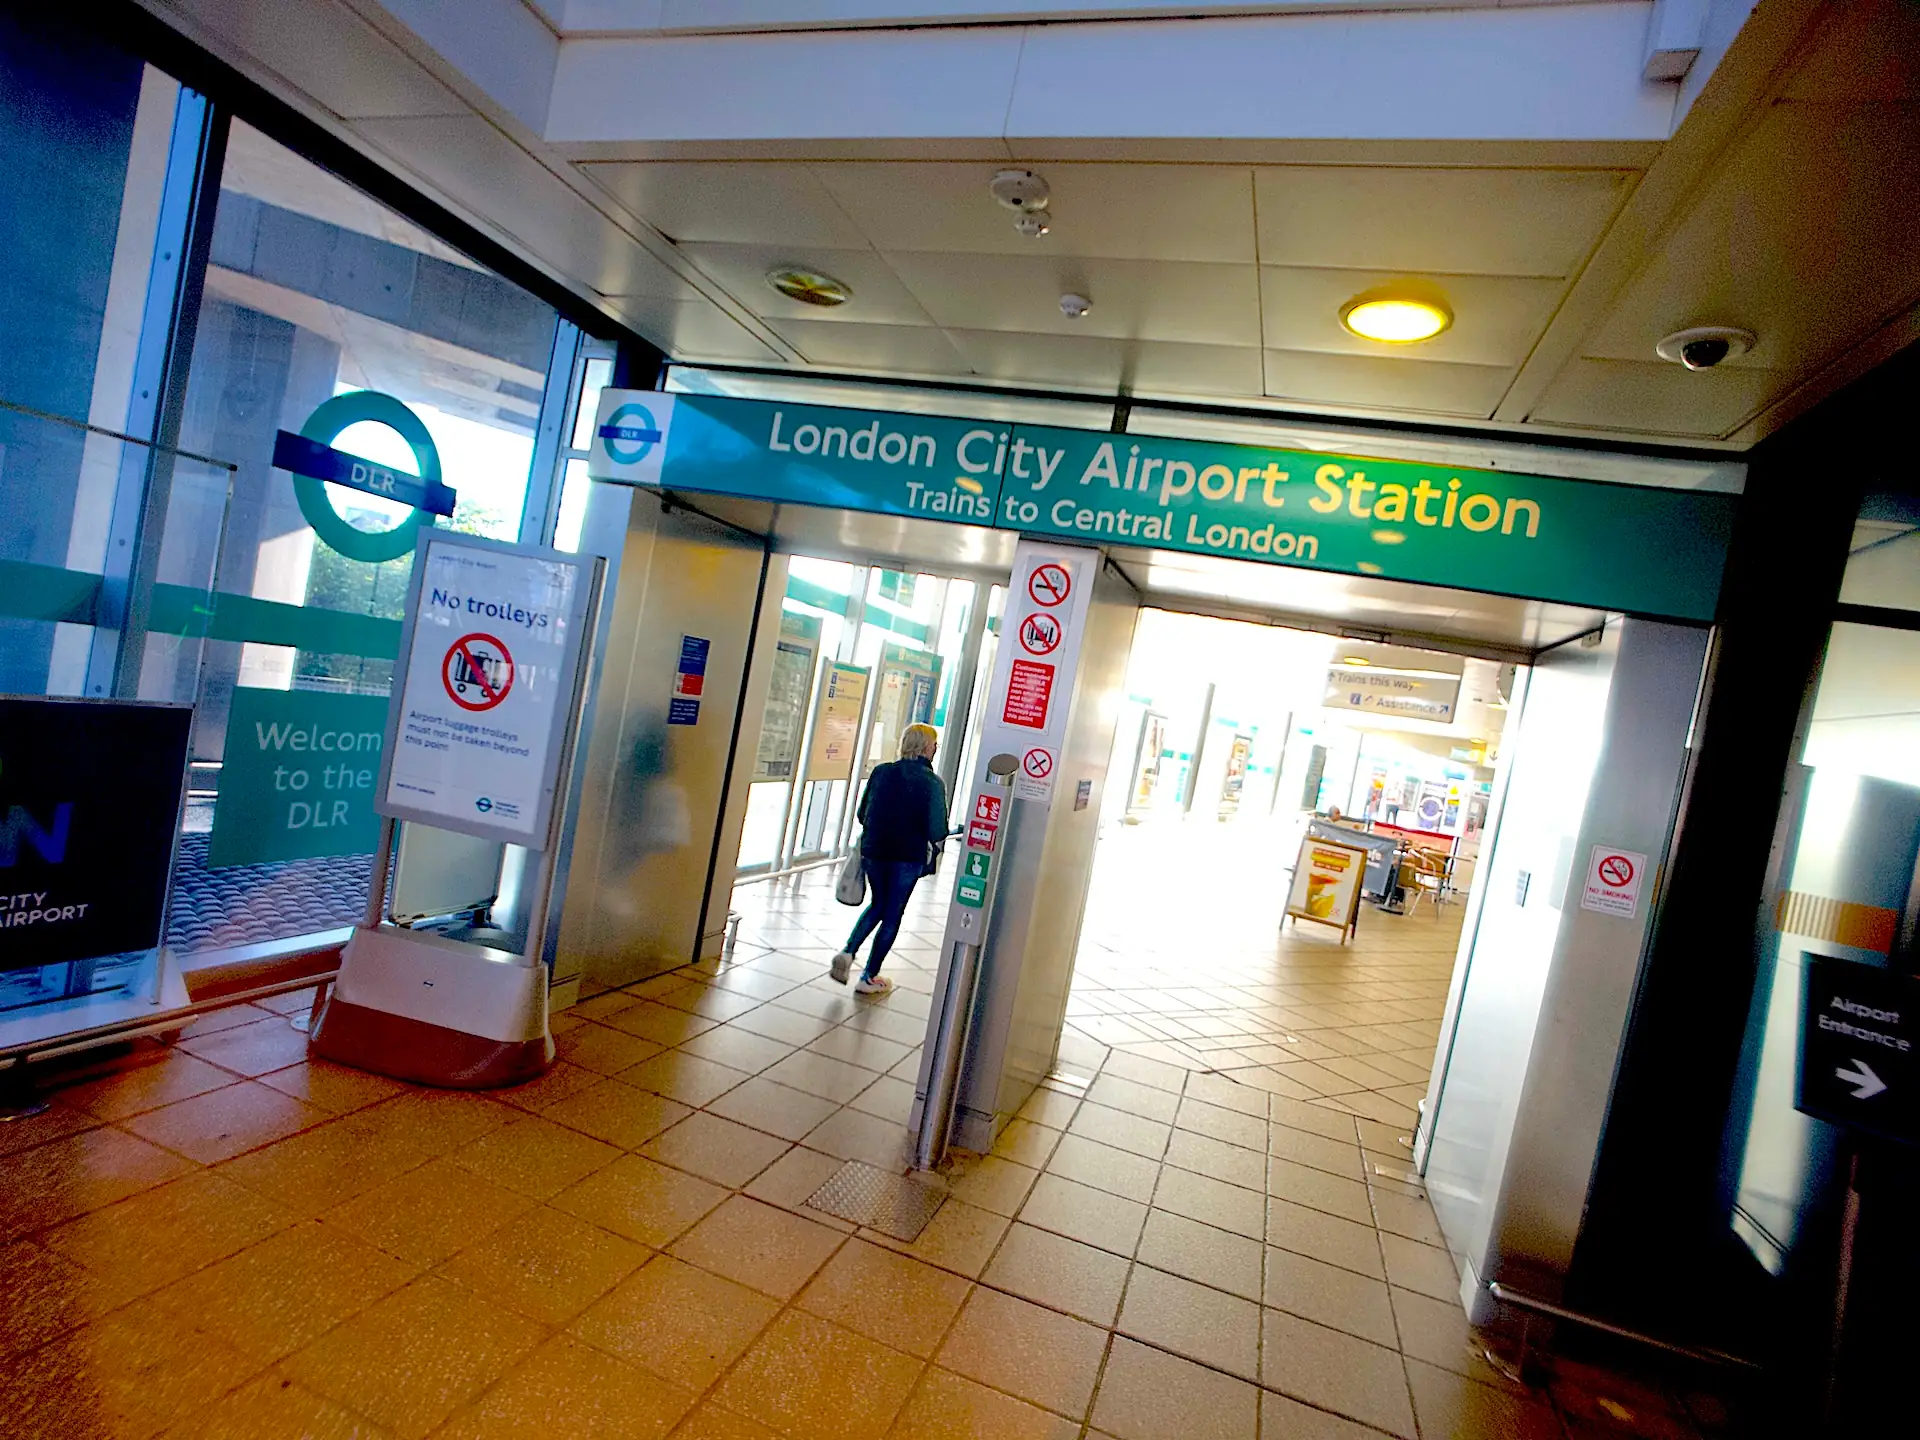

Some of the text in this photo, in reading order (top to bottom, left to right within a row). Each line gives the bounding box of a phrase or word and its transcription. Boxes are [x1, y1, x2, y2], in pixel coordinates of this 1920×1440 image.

[621, 430, 638, 438] DLR
[351, 463, 396, 494] DLR
[769, 411, 1541, 538] London City Airport Station
[906, 481, 1319, 560] Trains to Central London
[431, 587, 548, 629] No trolleys
[1338, 672, 1414, 691] Trains this way
[1376, 698, 1436, 713] Assistance
[255, 721, 382, 751] Welcom
[407, 723, 529, 757] must not be taken beyond
[409, 710, 518, 742] Airport luggage trolleys
[405, 734, 449, 751] this point
[274, 765, 309, 791] to
[323, 763, 372, 789] the
[287, 800, 349, 829] DLR
[0, 892, 47, 910] CITY
[1602, 888, 1633, 901] SMOKING
[1830, 996, 1900, 1024] Airport
[1818, 1014, 1911, 1052] Entrance
